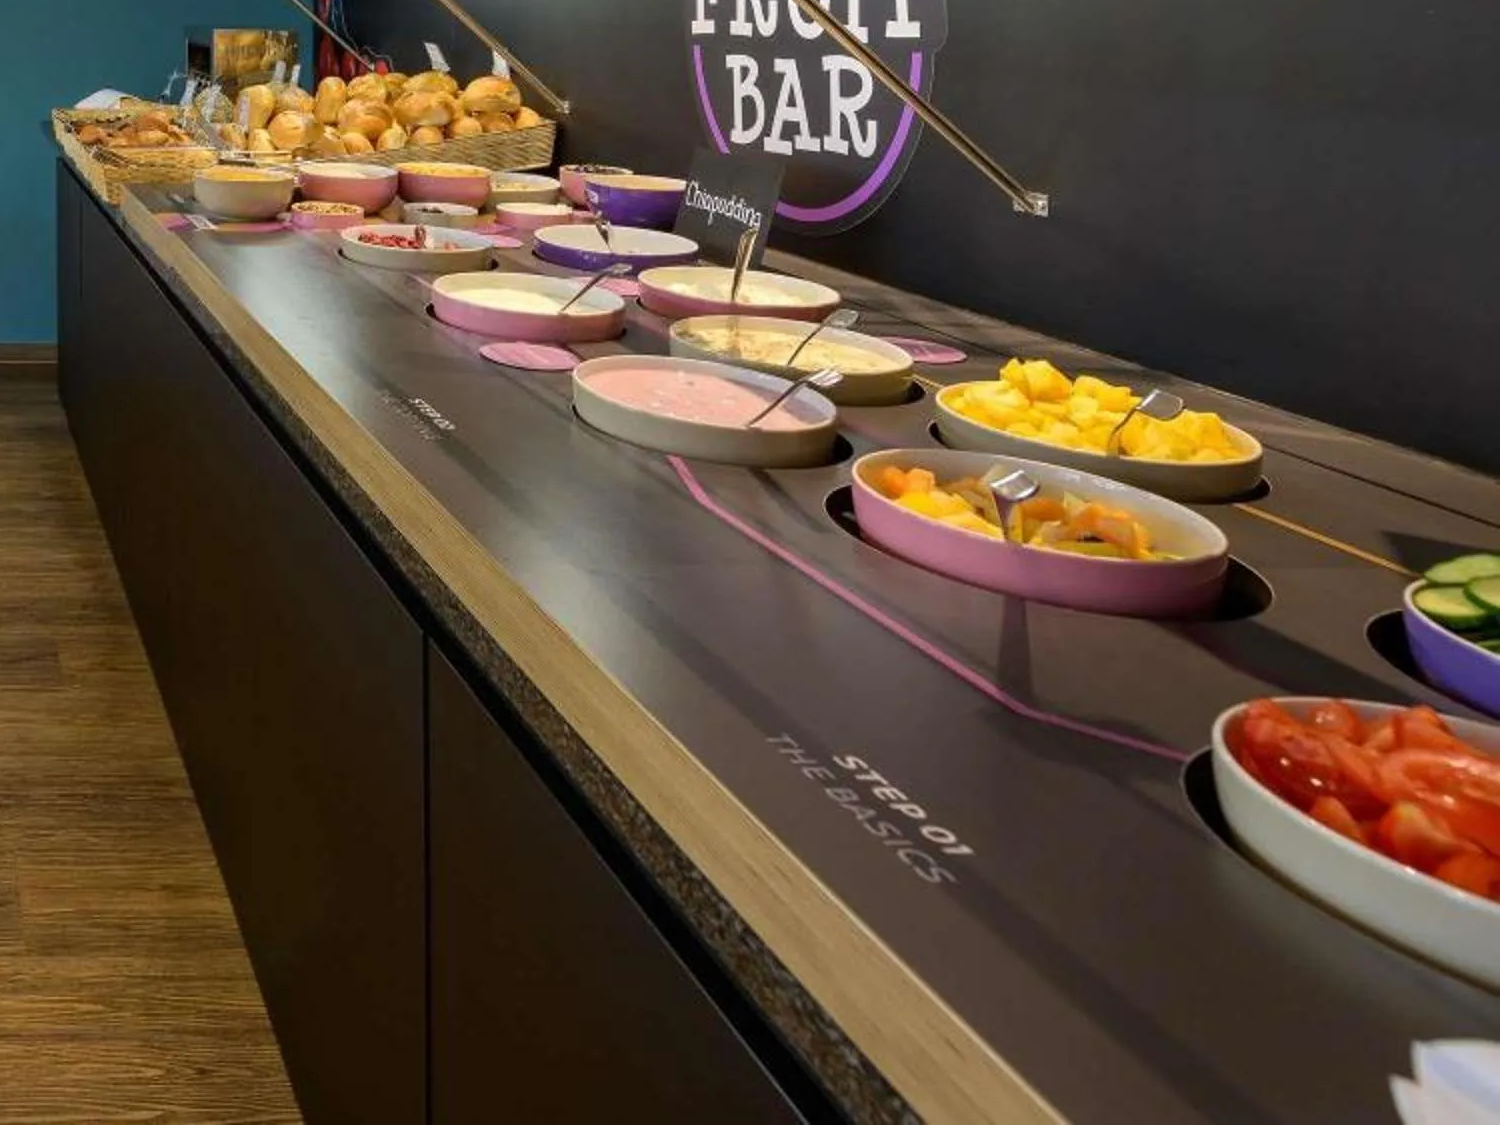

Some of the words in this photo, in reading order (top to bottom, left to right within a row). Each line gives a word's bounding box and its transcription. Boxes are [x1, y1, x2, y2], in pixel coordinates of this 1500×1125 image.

[725, 54, 878, 158] BAR
[765, 732, 836, 781] THE
[824, 787, 959, 885] BASICS
[832, 754, 927, 820] STEP
[919, 825, 976, 856] 01
